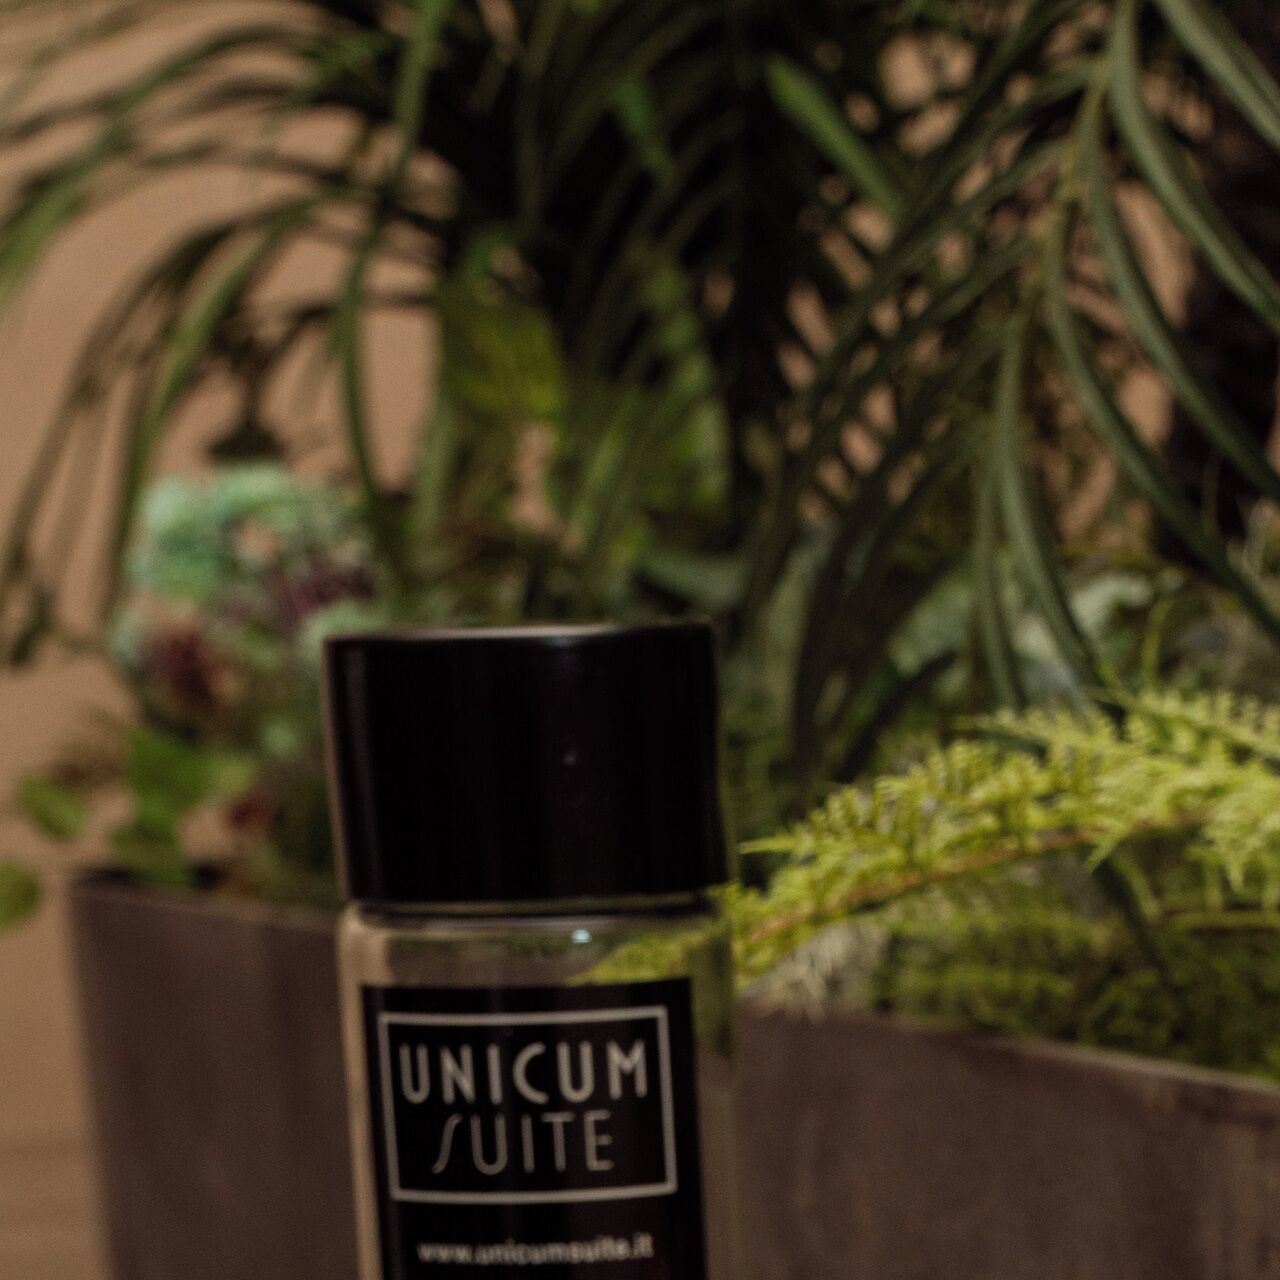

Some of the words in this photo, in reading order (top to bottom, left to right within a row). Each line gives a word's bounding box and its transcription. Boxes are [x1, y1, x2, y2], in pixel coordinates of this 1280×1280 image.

[399, 1038, 648, 1104] UNICUM
[431, 1109, 615, 1175] SUITE
[417, 1231, 655, 1266] www.unicumsuite.it
